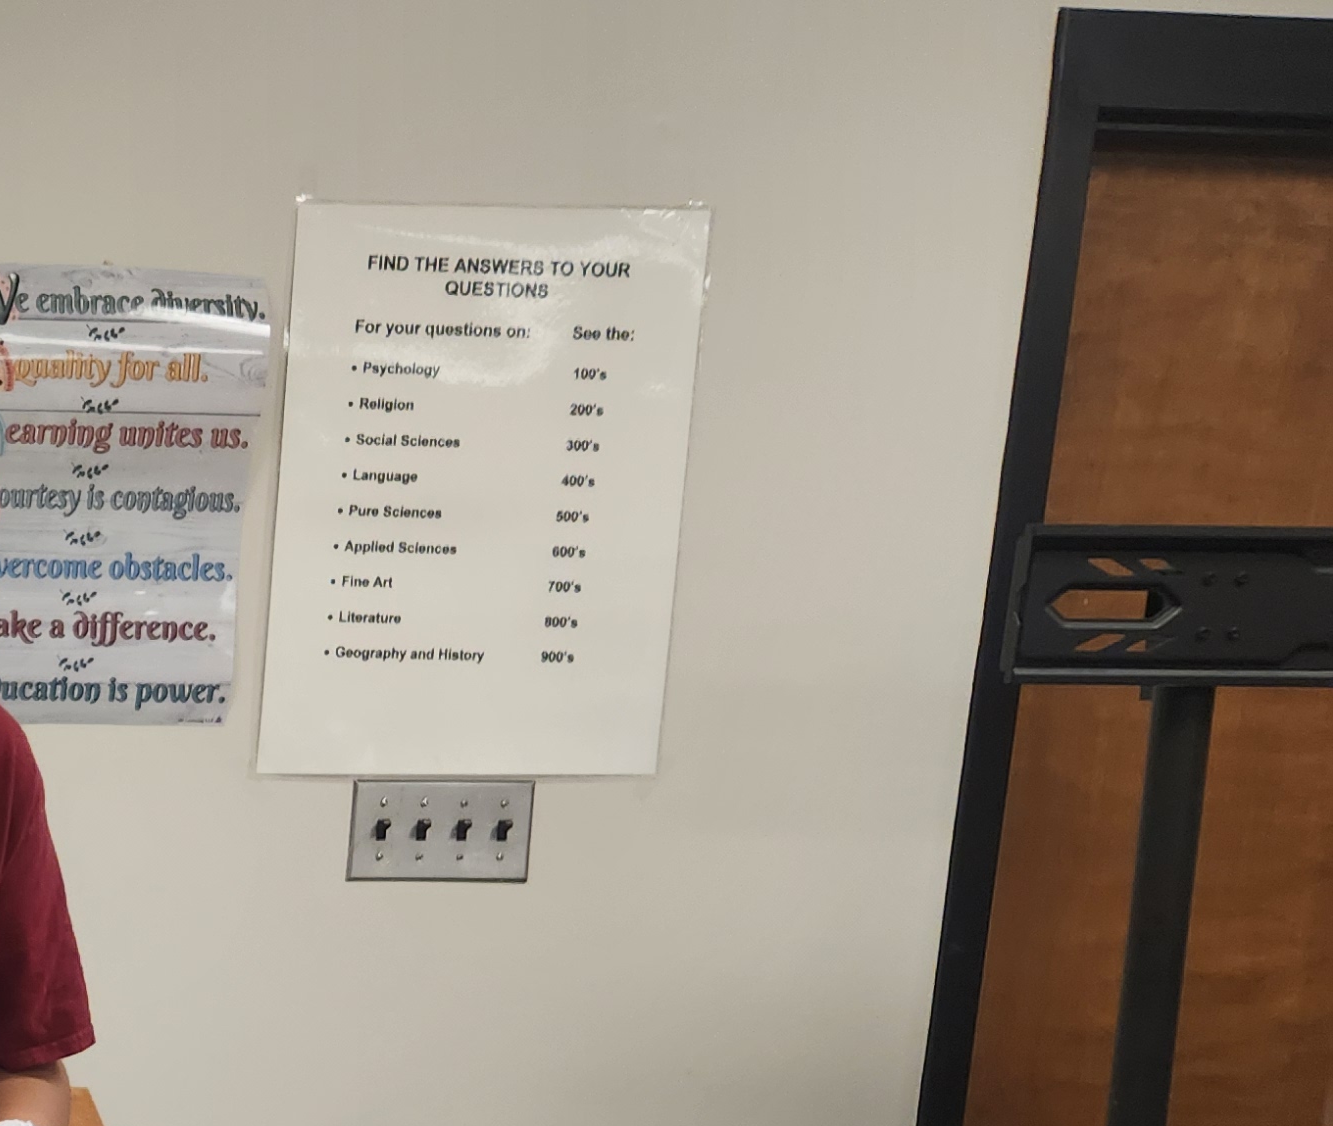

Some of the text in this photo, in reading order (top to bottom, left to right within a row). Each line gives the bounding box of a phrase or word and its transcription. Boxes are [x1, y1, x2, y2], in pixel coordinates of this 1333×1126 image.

[368, 255, 631, 278] FIND THE ANSWERS TO YOUR
[445, 280, 549, 299] QUESTIONS
[36, 288, 144, 315] embrace
[150, 290, 266, 321] diversity.
[354, 319, 530, 341] For your questions on:
[572, 326, 635, 343] See the:
[115, 352, 160, 388] for
[165, 353, 209, 382] all.
[362, 362, 440, 379] Psychology
[573, 367, 607, 381] 100's
[359, 397, 415, 414] Religion
[569, 403, 604, 417] 200's
[119, 419, 202, 448] unites
[209, 425, 249, 450] us.
[356, 433, 461, 449] Social Sciences
[565, 439, 600, 453] 300's
[352, 469, 418, 486] Language
[561, 474, 595, 488] 400's
[87, 484, 104, 511] is
[110, 485, 241, 520] contagious.
[348, 504, 442, 521] Pure Sciences
[555, 509, 589, 524] 500's
[344, 540, 457, 557] Applied Sciences
[551, 545, 586, 559] 600's
[108, 553, 233, 583] obstacles.
[341, 575, 393, 590] Fine Art
[547, 580, 582, 594] 700's
[338, 610, 402, 626] Literature
[543, 615, 578, 629] 800's
[49, 619, 66, 640] a
[73, 610, 215, 645] difference.
[335, 646, 484, 664] Geography and History
[540, 650, 574, 665] 900's
[108, 677, 128, 702] is
[135, 682, 225, 711] power.
